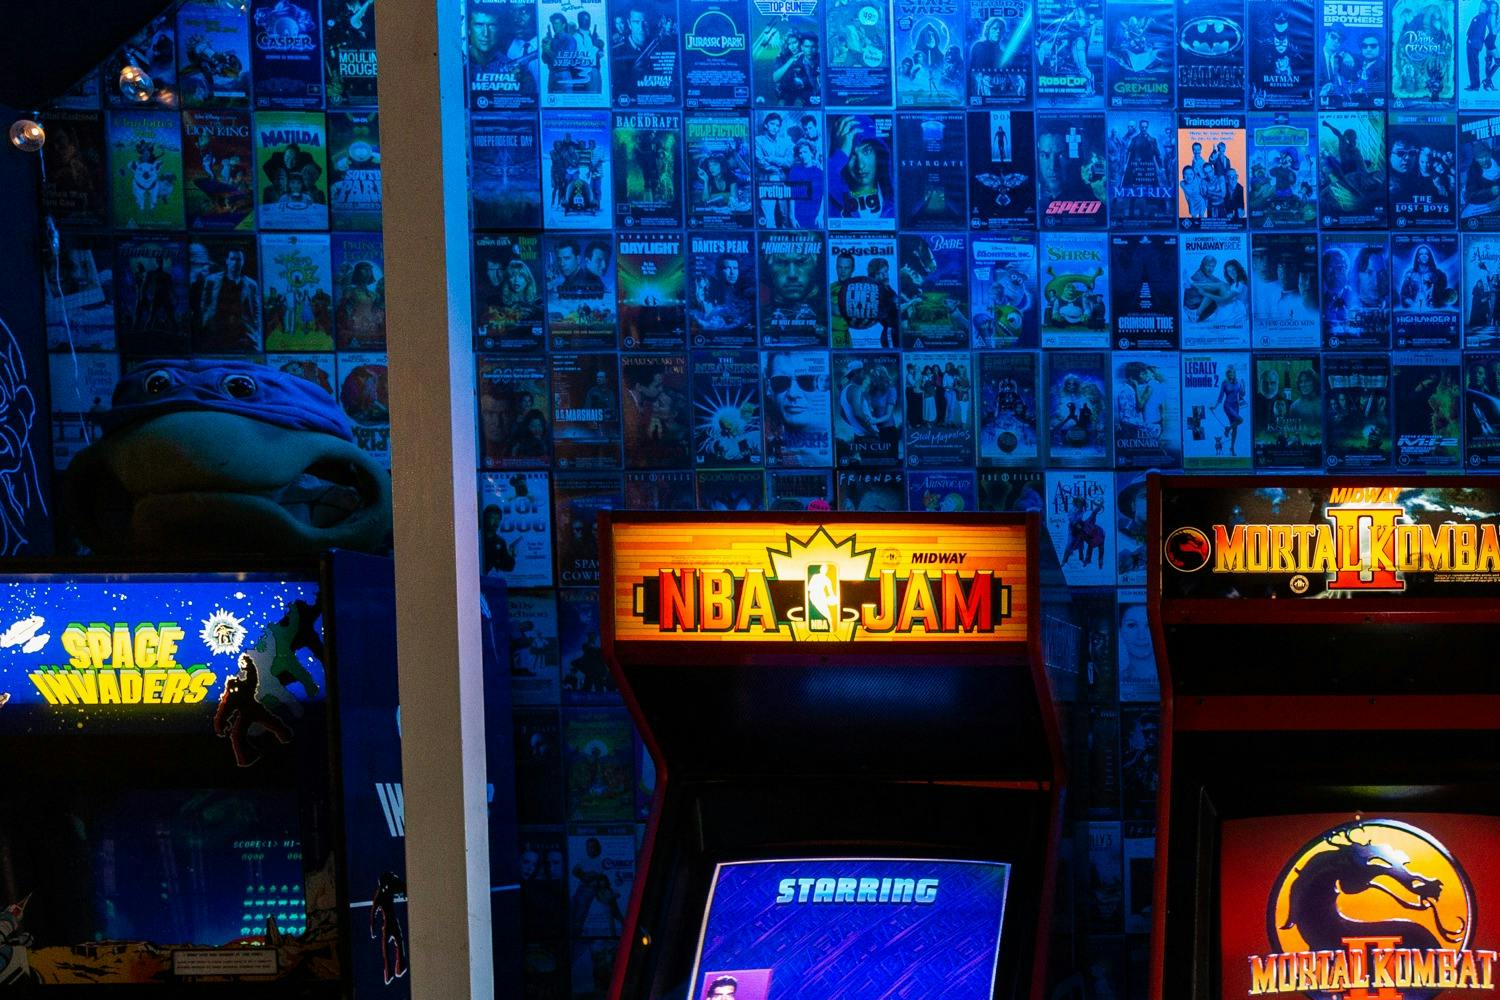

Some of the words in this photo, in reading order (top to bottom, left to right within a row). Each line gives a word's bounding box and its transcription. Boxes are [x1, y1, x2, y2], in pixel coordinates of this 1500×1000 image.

[768, 1, 784, 12] TOP
[785, 1, 803, 12] GUN
[1324, 6, 1384, 16] BLUES
[1324, 16, 1384, 24] BROTHERS
[721, 34, 743, 49] PARK
[476, 73, 517, 82] LETHAL
[1264, 75, 1300, 83] BATMAN
[472, 81, 520, 91] WEAPON
[1114, 81, 1169, 94] GREMLINS
[616, 116, 679, 128] BACKDRAFT
[1184, 116, 1240, 128] Trainspotting
[186, 126, 214, 136] LION
[217, 126, 248, 136] KING
[1113, 186, 1172, 199] MATRIX
[1412, 196, 1432, 204] THE
[1046, 201, 1101, 215] SPEED
[619, 242, 679, 254] DAYLIGHT
[692, 240, 724, 254] DANTE'S
[725, 240, 749, 253] PEAK
[1185, 241, 1223, 250] RUNAWAY
[1118, 317, 1151, 329] CRIMSON
[1153, 317, 1174, 329] TIDE
[1184, 360, 1217, 376] LEGALLY
[849, 442, 866, 452] TIN
[873, 442, 892, 452] CUP
[1329, 487, 1402, 504] MIDWAY
[1212, 524, 1365, 573] MORTAL
[911, 552, 967, 564] MIDWAY
[658, 568, 780, 633] NBA
[861, 568, 996, 633] JAM
[61, 622, 185, 669] SPACE
[29, 665, 217, 705] INVADERS
[776, 878, 939, 904] STARRING
[1248, 950, 1369, 995] MORTAL
[1372, 948, 1496, 990] KOMBAT
